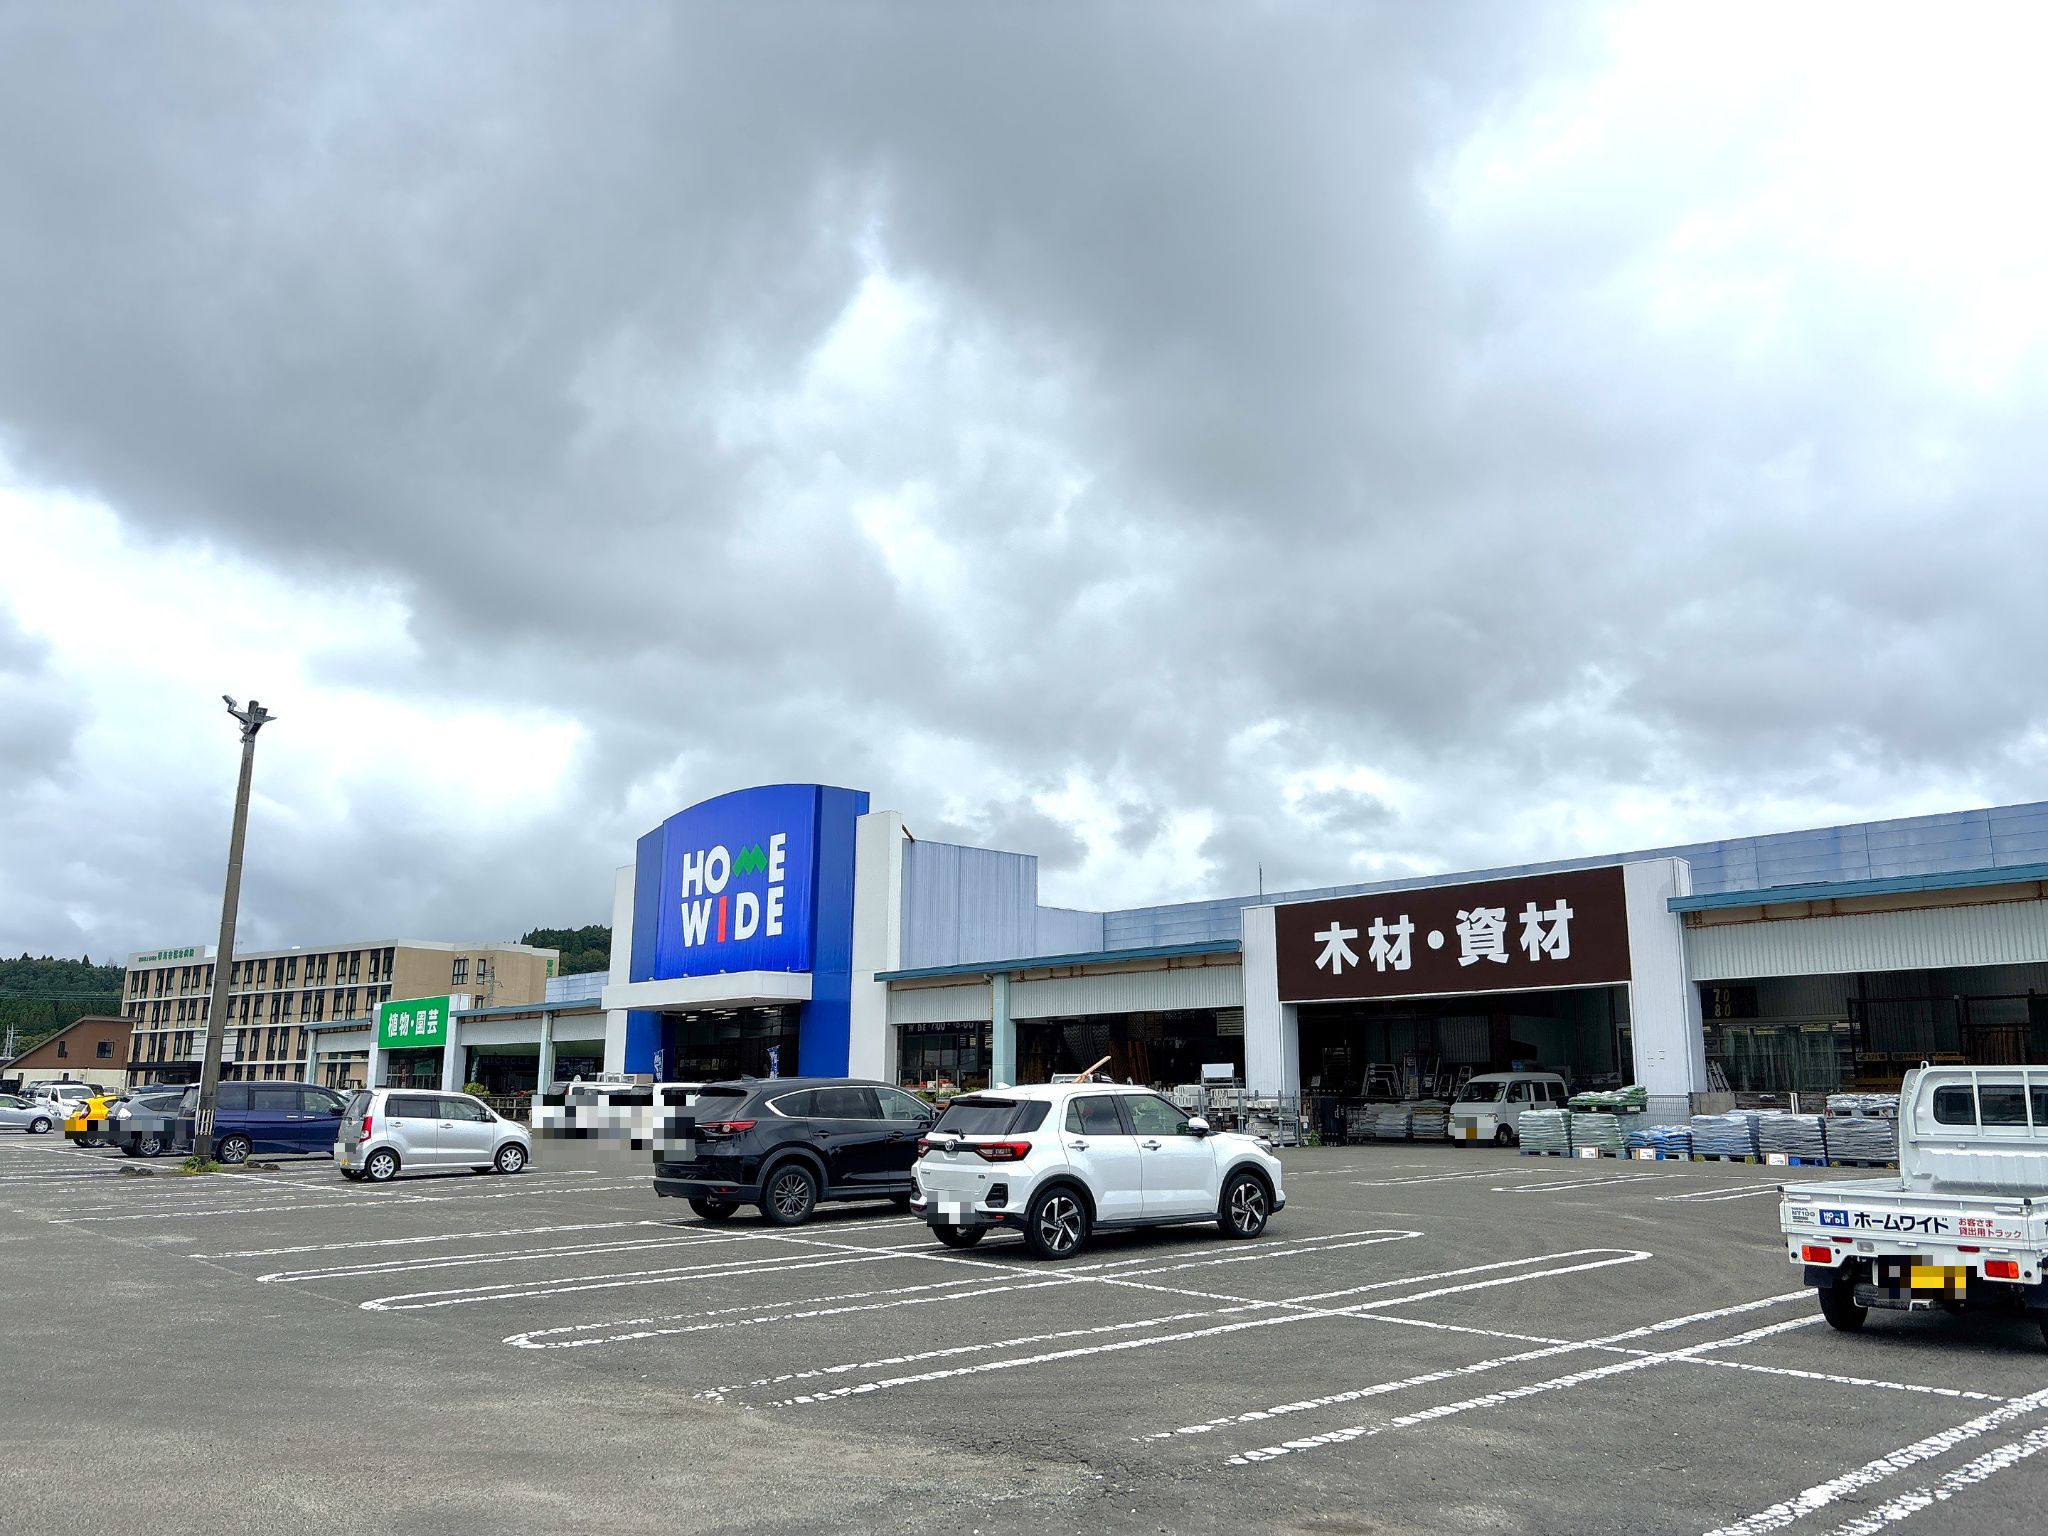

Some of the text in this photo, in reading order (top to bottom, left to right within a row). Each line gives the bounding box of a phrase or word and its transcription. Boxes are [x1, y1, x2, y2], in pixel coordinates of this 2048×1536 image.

[681, 832, 786, 898] HOME
[681, 885, 784, 947] WIDE
[1314, 899, 1574, 975] 木材・資材
[388, 1008, 439, 1038] 植物・園芸
[1854, 1211, 1949, 1234] ホームワイド
[1958, 1218, 1994, 1228] お客さま
[1959, 1227, 2022, 1239] 貸出用トラック
